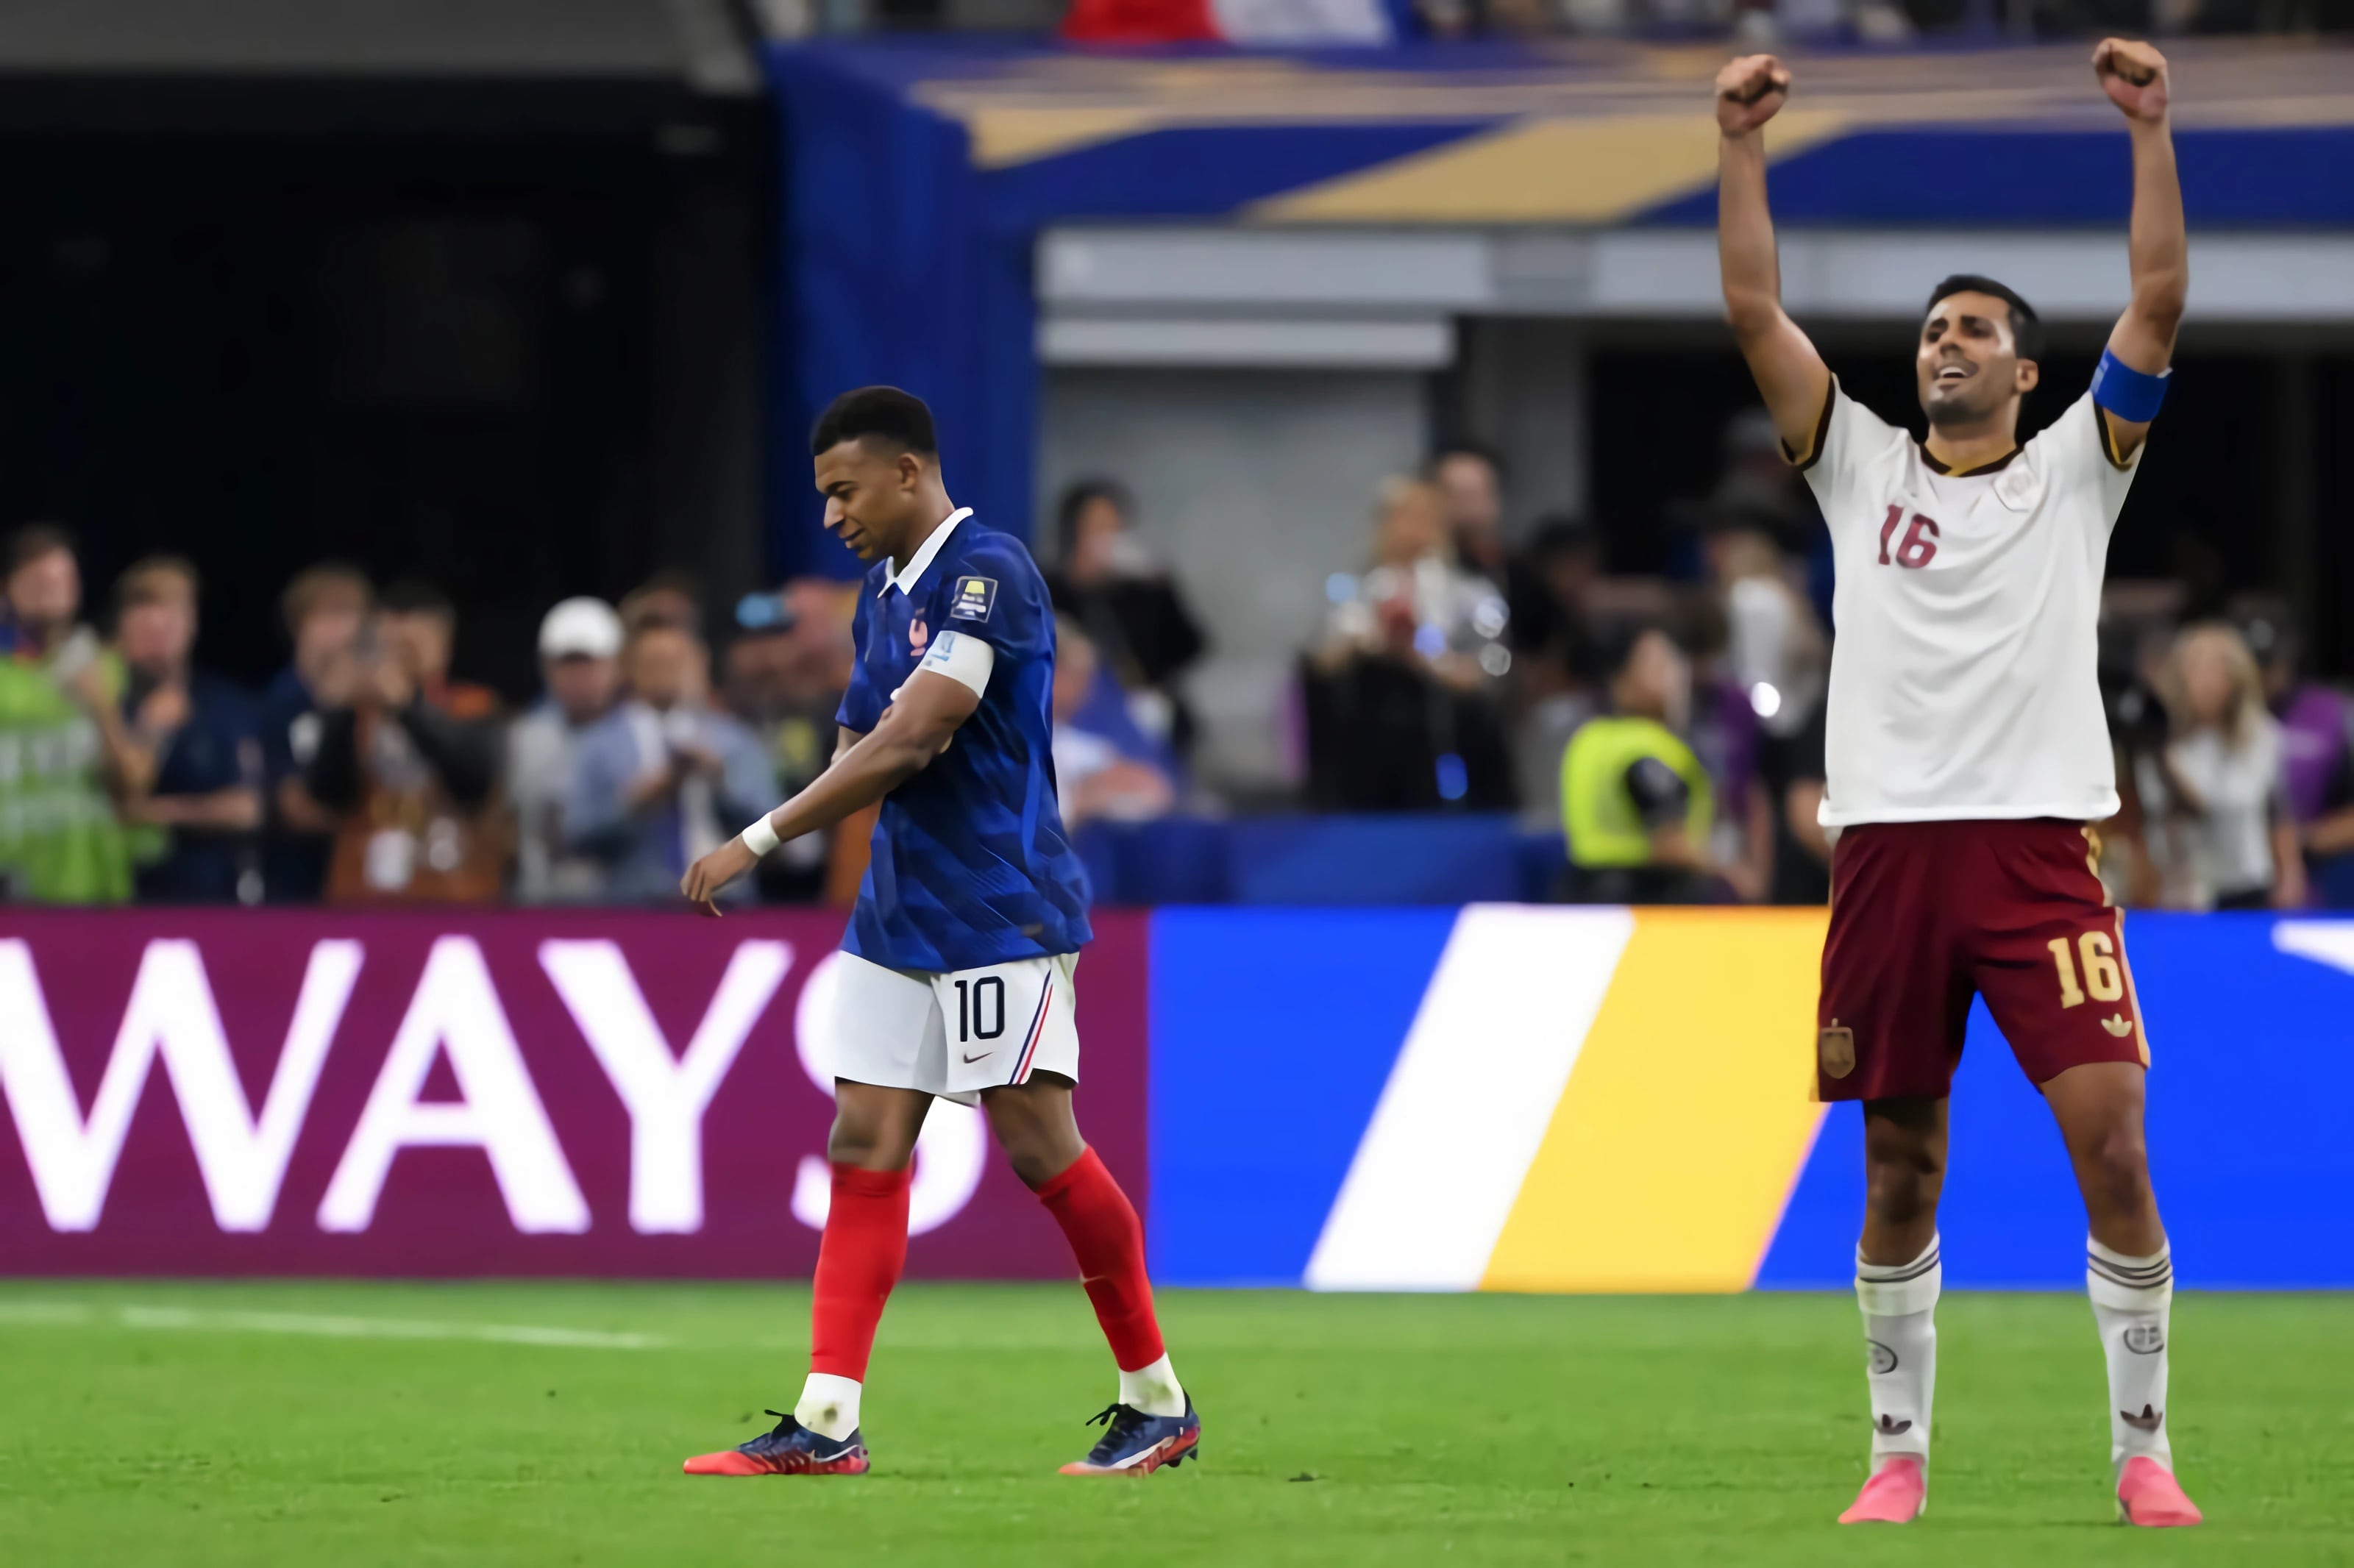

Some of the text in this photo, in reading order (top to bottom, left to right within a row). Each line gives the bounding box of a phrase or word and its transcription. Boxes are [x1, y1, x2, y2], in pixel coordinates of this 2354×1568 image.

[1879, 504, 1940, 569] 16
[2047, 930, 2123, 1008] 16
[954, 975, 1005, 1042] 10
